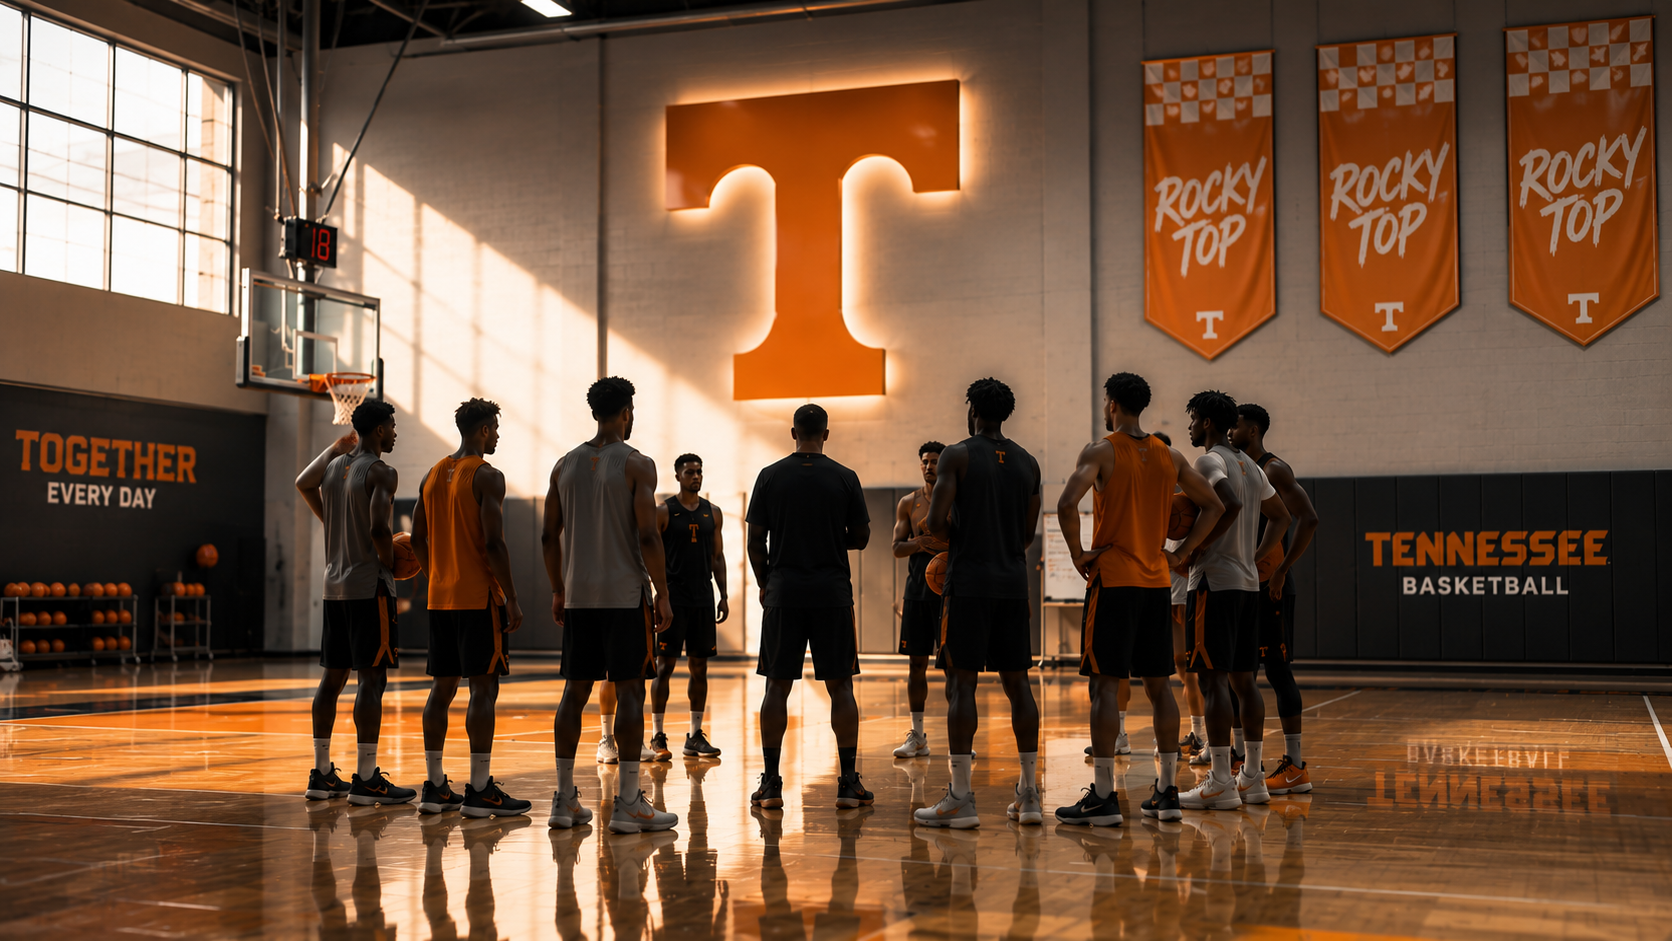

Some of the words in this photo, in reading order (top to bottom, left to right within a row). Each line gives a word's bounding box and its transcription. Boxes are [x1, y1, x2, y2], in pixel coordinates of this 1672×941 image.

[1330, 142, 1450, 221] ROCKY
[1519, 125, 1647, 209] ROCKY
[1154, 156, 1267, 232] ROCKY
[1348, 202, 1428, 268] TOP
[1540, 188, 1623, 256] TOP
[311, 227, 331, 261] 18
[665, 79, 960, 401] T
[1172, 214, 1246, 278] TOP
[1196, 310, 1224, 340] T
[1374, 302, 1404, 332] T
[1567, 292, 1600, 324] T
[15, 429, 197, 483] TOGETHER
[995, 450, 1006, 464] T
[47, 482, 113, 506] EVERY
[119, 486, 156, 509] DAY
[688, 523, 699, 543] T
[1365, 530, 1609, 567] TENNESSEE
[1403, 576, 1569, 595] BASKETBALL
[1258, 646, 1269, 658] T
